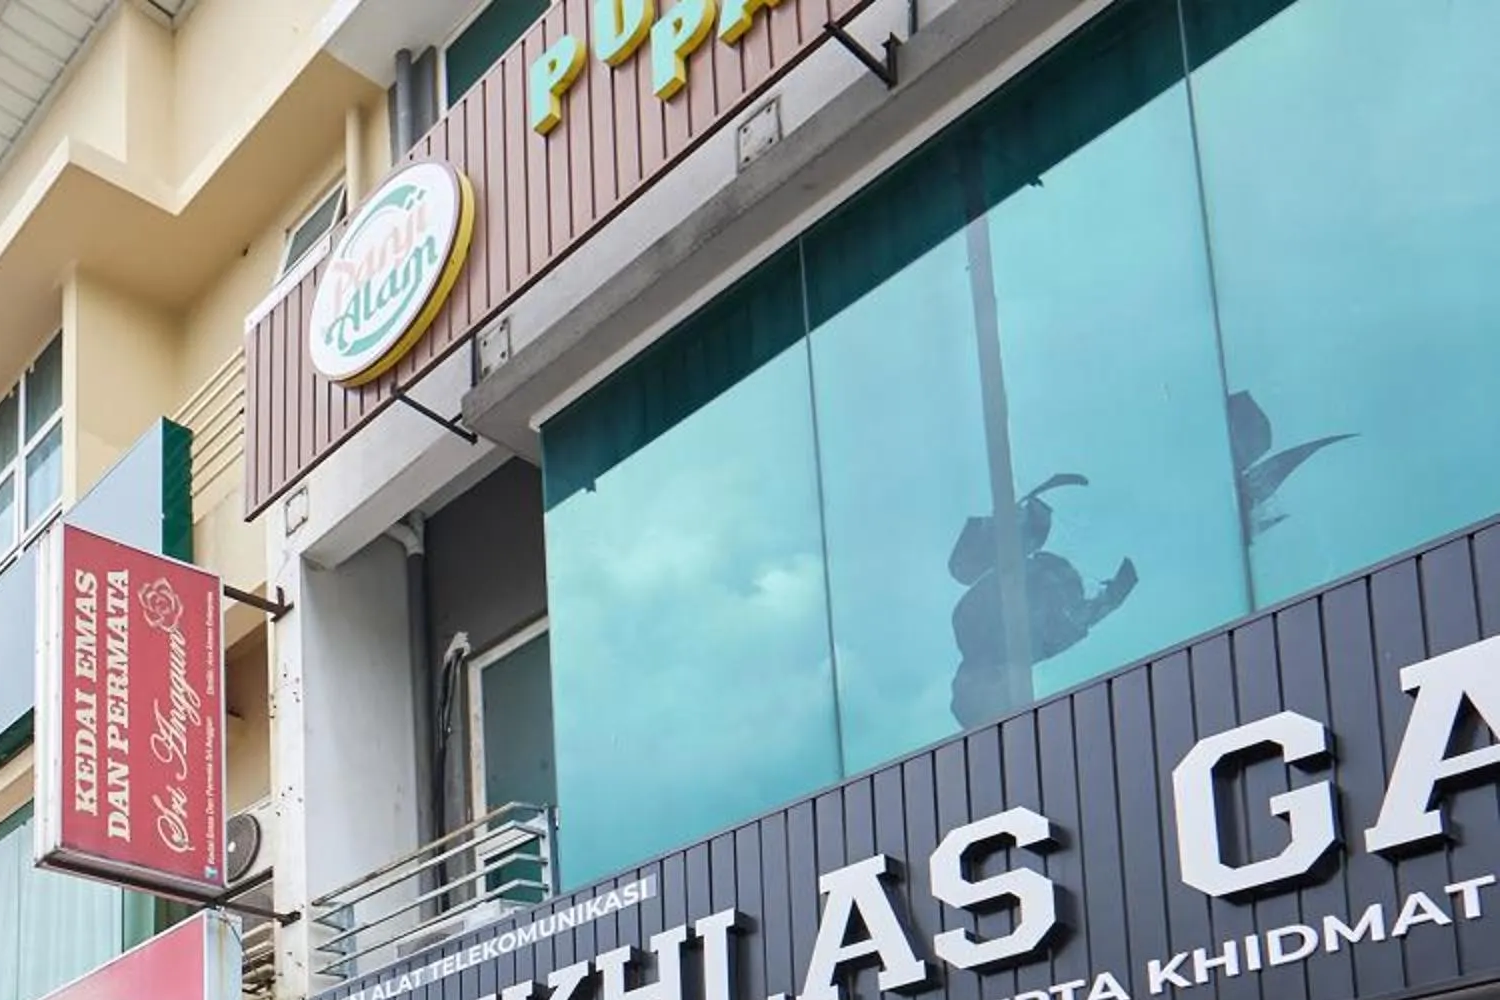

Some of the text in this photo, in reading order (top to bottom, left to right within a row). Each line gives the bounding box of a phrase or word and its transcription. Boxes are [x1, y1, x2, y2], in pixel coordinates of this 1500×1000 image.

[75, 569, 98, 816] KEDAI EMAS
[106, 569, 131, 842] DAN PERMATA
[150, 628, 202, 853] Sri Anggun
[1172, 635, 1500, 898] GA
[425, 878, 650, 987] TELEKOMUNIKASI
[1148, 874, 1497, 996] KHIDMAT
